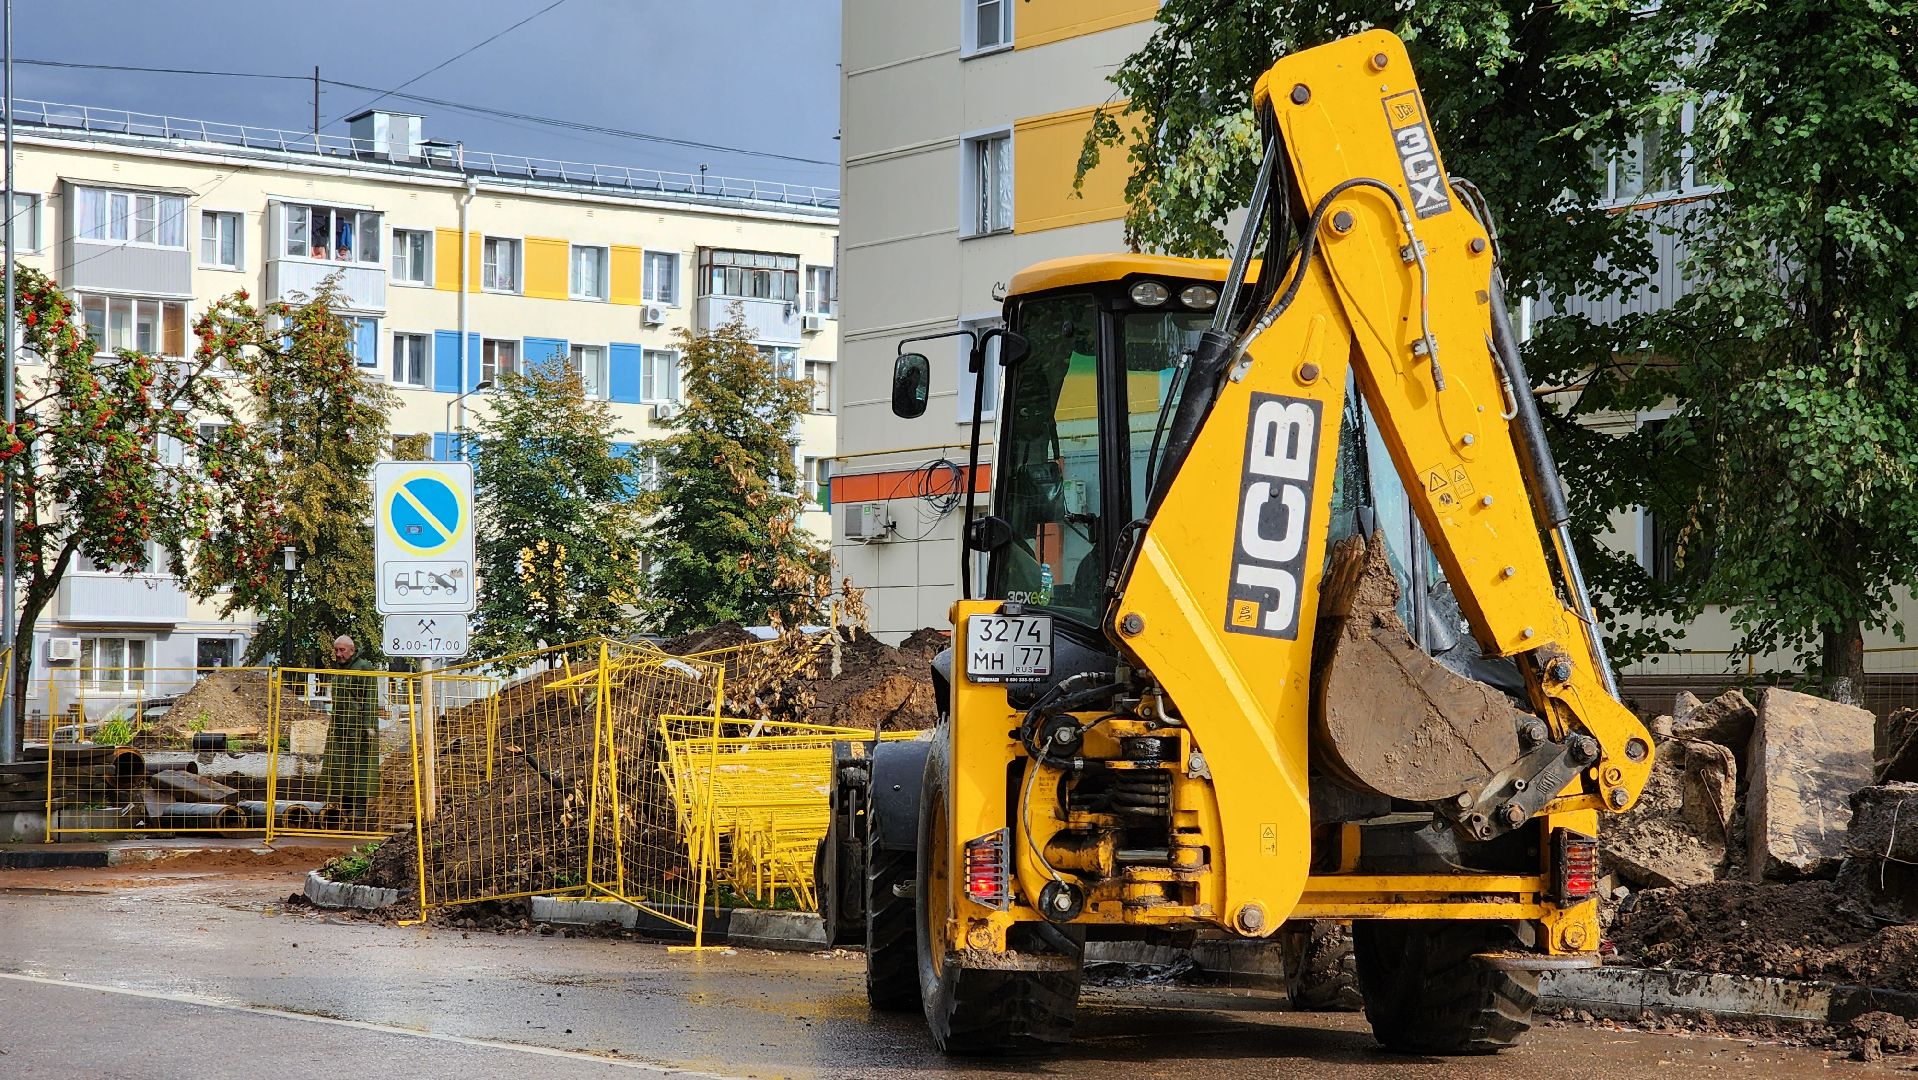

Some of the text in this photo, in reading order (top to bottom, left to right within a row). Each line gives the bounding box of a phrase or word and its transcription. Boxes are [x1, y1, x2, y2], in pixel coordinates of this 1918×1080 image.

[1395, 103, 1414, 119] JCB
[1397, 127, 1448, 209] 3CX
[1237, 401, 1315, 630] JCB
[979, 619, 1041, 643] 3274
[392, 637, 460, 651] 8.00-17.00
[1020, 647, 1044, 666] 77
[1015, 666, 1033, 674] RUS
